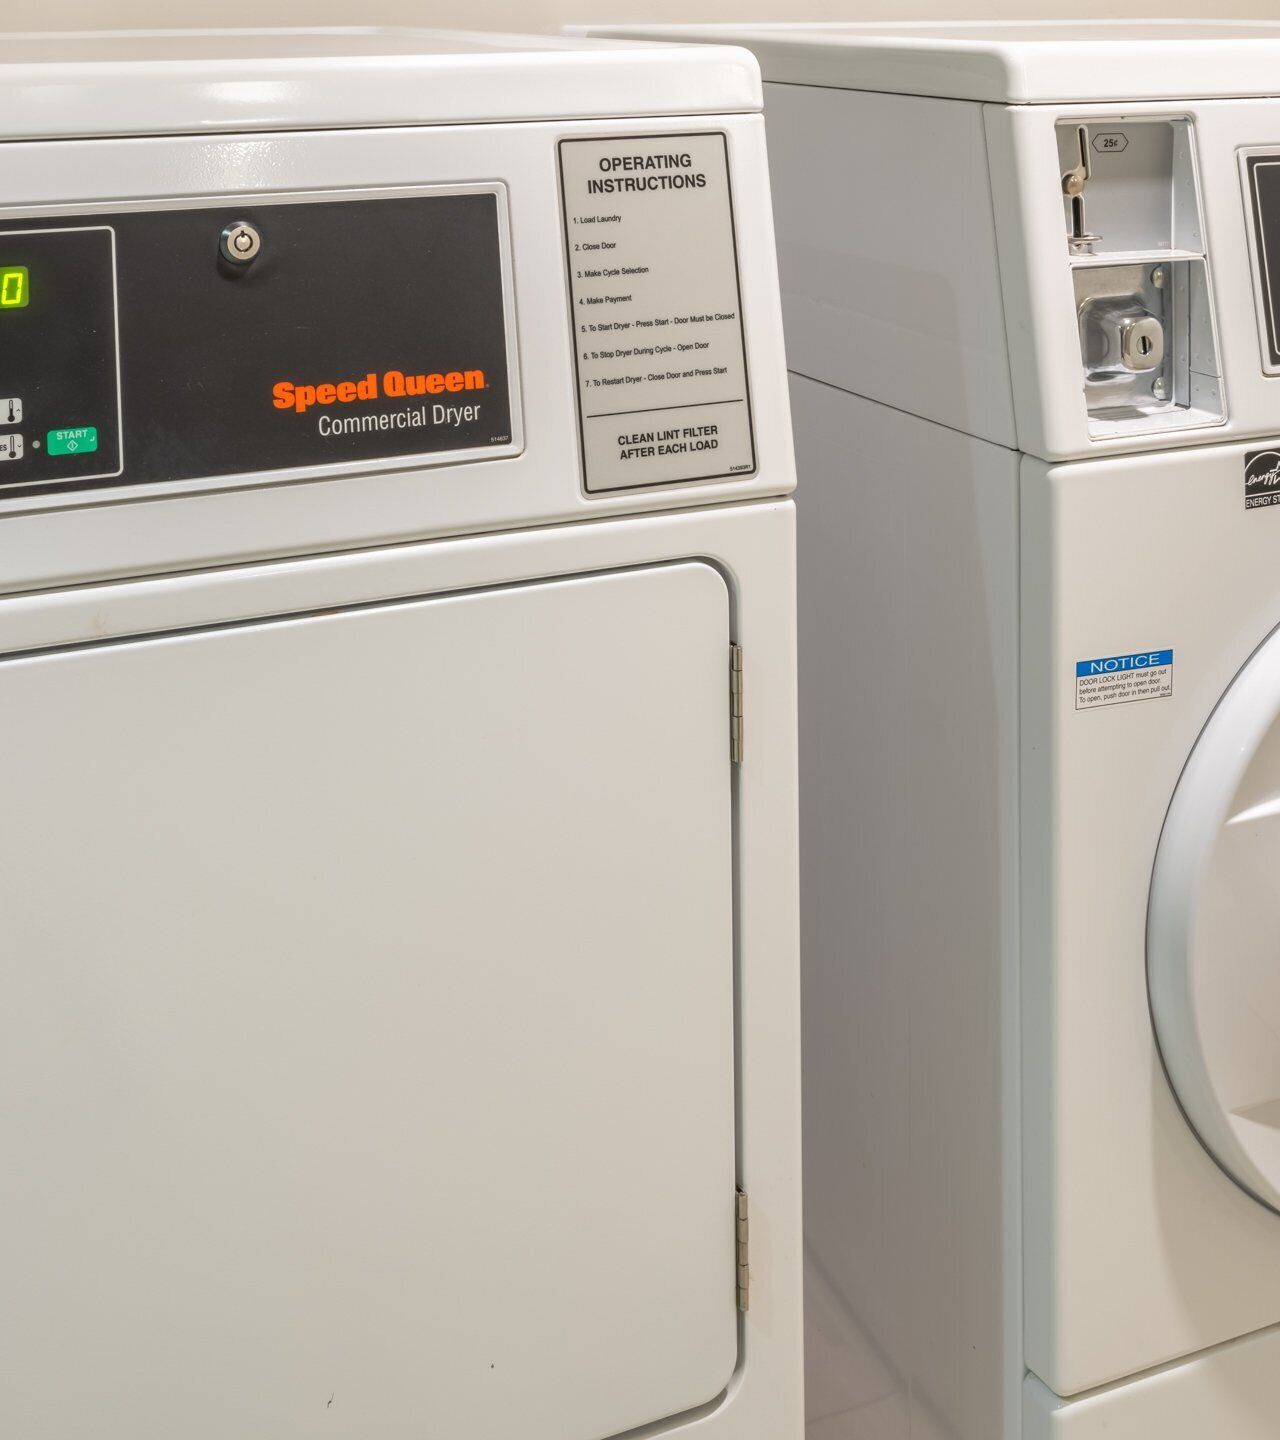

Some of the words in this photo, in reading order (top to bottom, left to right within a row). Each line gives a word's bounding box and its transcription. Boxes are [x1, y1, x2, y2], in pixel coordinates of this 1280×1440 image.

[599, 154, 692, 172] OPERATING
[588, 173, 706, 194] INSTRUCTIONS
[580, 216, 596, 224] Load
[597, 215, 621, 223] Laundry
[582, 243, 600, 251] Close
[577, 271, 583, 279] 3.
[603, 269, 620, 277] Cycle
[621, 267, 649, 275] Selection
[604, 294, 632, 304] Payment
[581, 325, 587, 333] 5.
[588, 324, 597, 332] To
[597, 323, 613, 331] Start
[613, 322, 631, 330] Dryer
[654, 318, 669, 326] Start
[714, 312, 735, 321] Closed
[583, 352, 589, 360] 6.
[600, 351, 614, 359] Stop
[615, 349, 632, 358] Dryer
[655, 345, 672, 354] Cycle
[677, 344, 694, 352] Open
[592, 379, 601, 387] To
[602, 377, 625, 386] Restart
[625, 376, 642, 384] Dryer
[682, 370, 694, 378] and
[713, 367, 727, 375] Start
[272, 373, 378, 412] Speed
[383, 370, 484, 397] Queen
[319, 406, 426, 436] Commercial
[433, 405, 481, 425] Dryer
[55, 429, 88, 440] START
[618, 432, 654, 446] CLEAN
[657, 429, 680, 441] LINT
[683, 425, 718, 438] FILTER
[620, 446, 655, 460] AFTER
[658, 443, 687, 455] EACH
[690, 439, 718, 451] LOAD
[1246, 496, 1271, 508] ENERGY
[1090, 653, 1160, 673] NOTICE
[1079, 677, 1098, 687] DOOR
[1099, 675, 1116, 684] LOCK
[1117, 672, 1135, 681] LIGHT
[1149, 670, 1157, 678] go
[1098, 683, 1126, 692] attempting
[1133, 680, 1147, 688] open
[1087, 695, 1102, 703] open,
[1103, 692, 1117, 701] push
[1150, 686, 1160, 694] pull
